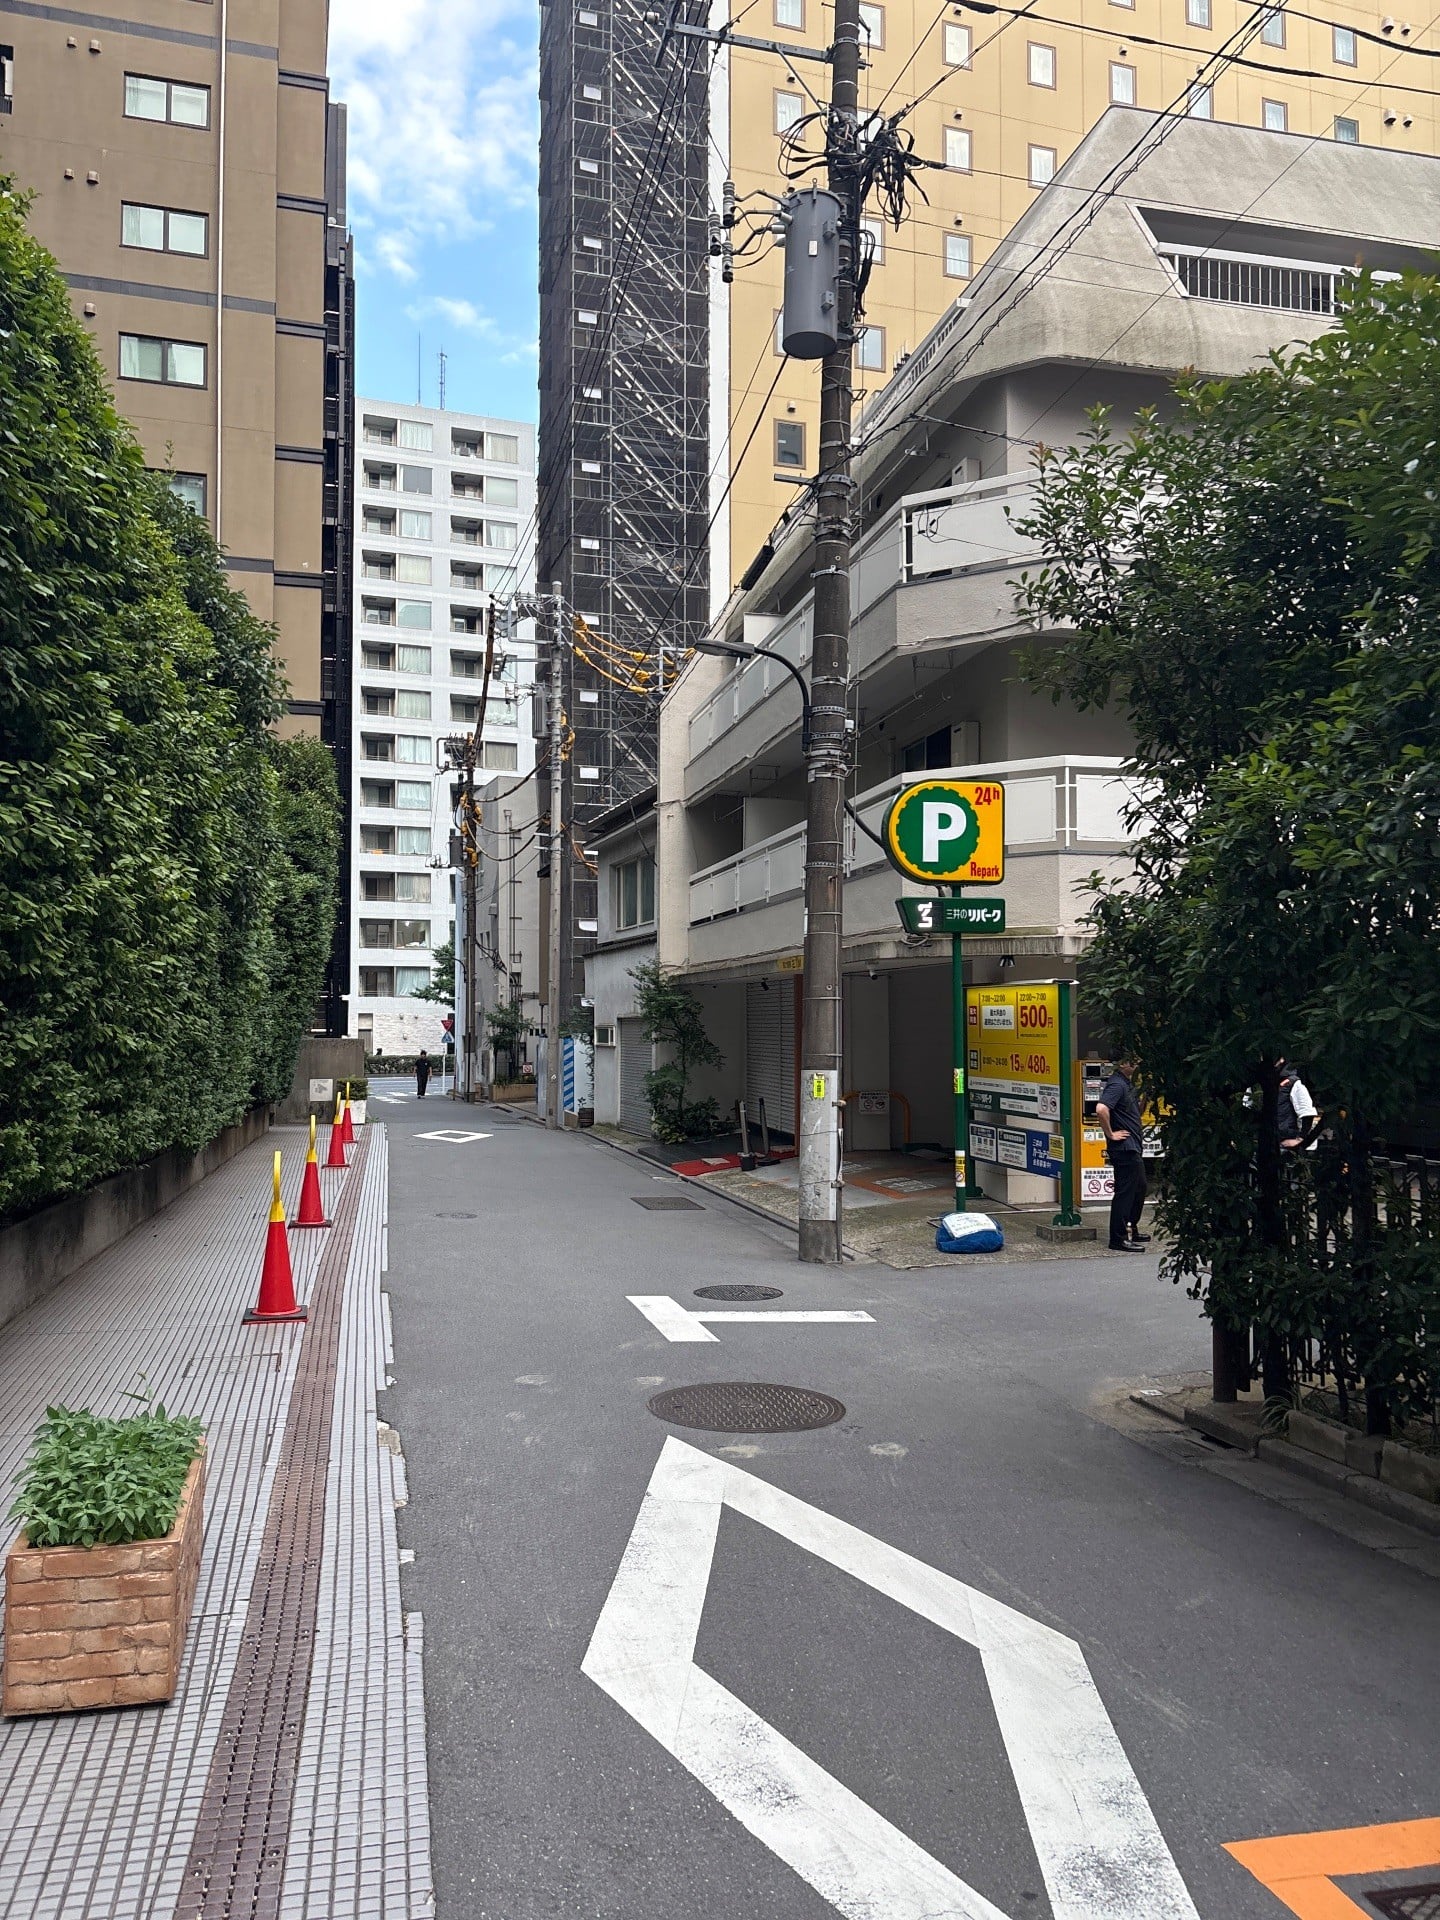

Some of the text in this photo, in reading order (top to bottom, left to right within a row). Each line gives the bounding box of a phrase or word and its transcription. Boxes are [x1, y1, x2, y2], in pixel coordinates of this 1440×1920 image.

[974, 786, 1000, 806] 24h
[922, 801, 967, 863] P
[970, 862, 1000, 879] Repark
[946, 908, 1001, 922] 三井のリパーク
